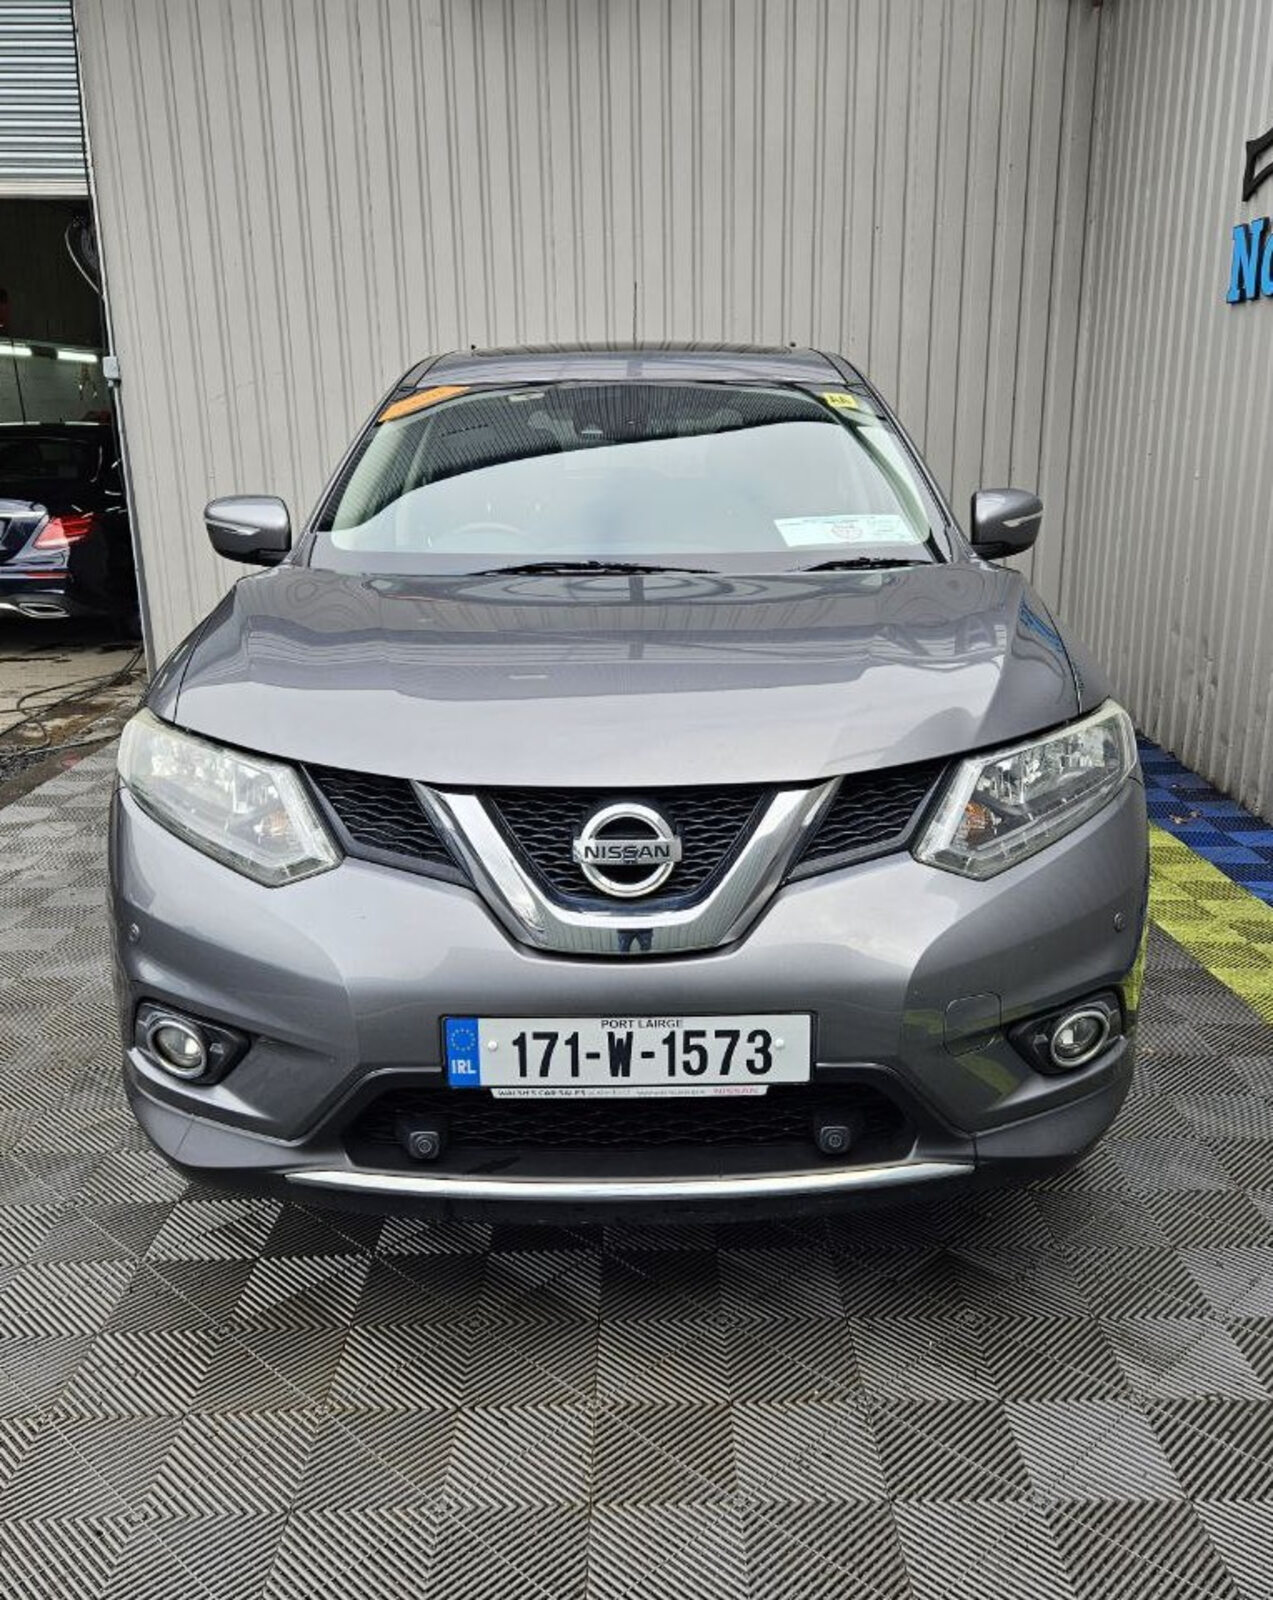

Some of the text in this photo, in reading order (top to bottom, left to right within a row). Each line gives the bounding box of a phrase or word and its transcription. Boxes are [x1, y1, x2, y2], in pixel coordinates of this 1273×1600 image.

[584, 845, 671, 859] NISSAN
[601, 1018, 683, 1029] PORT LAIRGE
[512, 1030, 773, 1077] 171-W-1573
[451, 1059, 477, 1074] IRL
